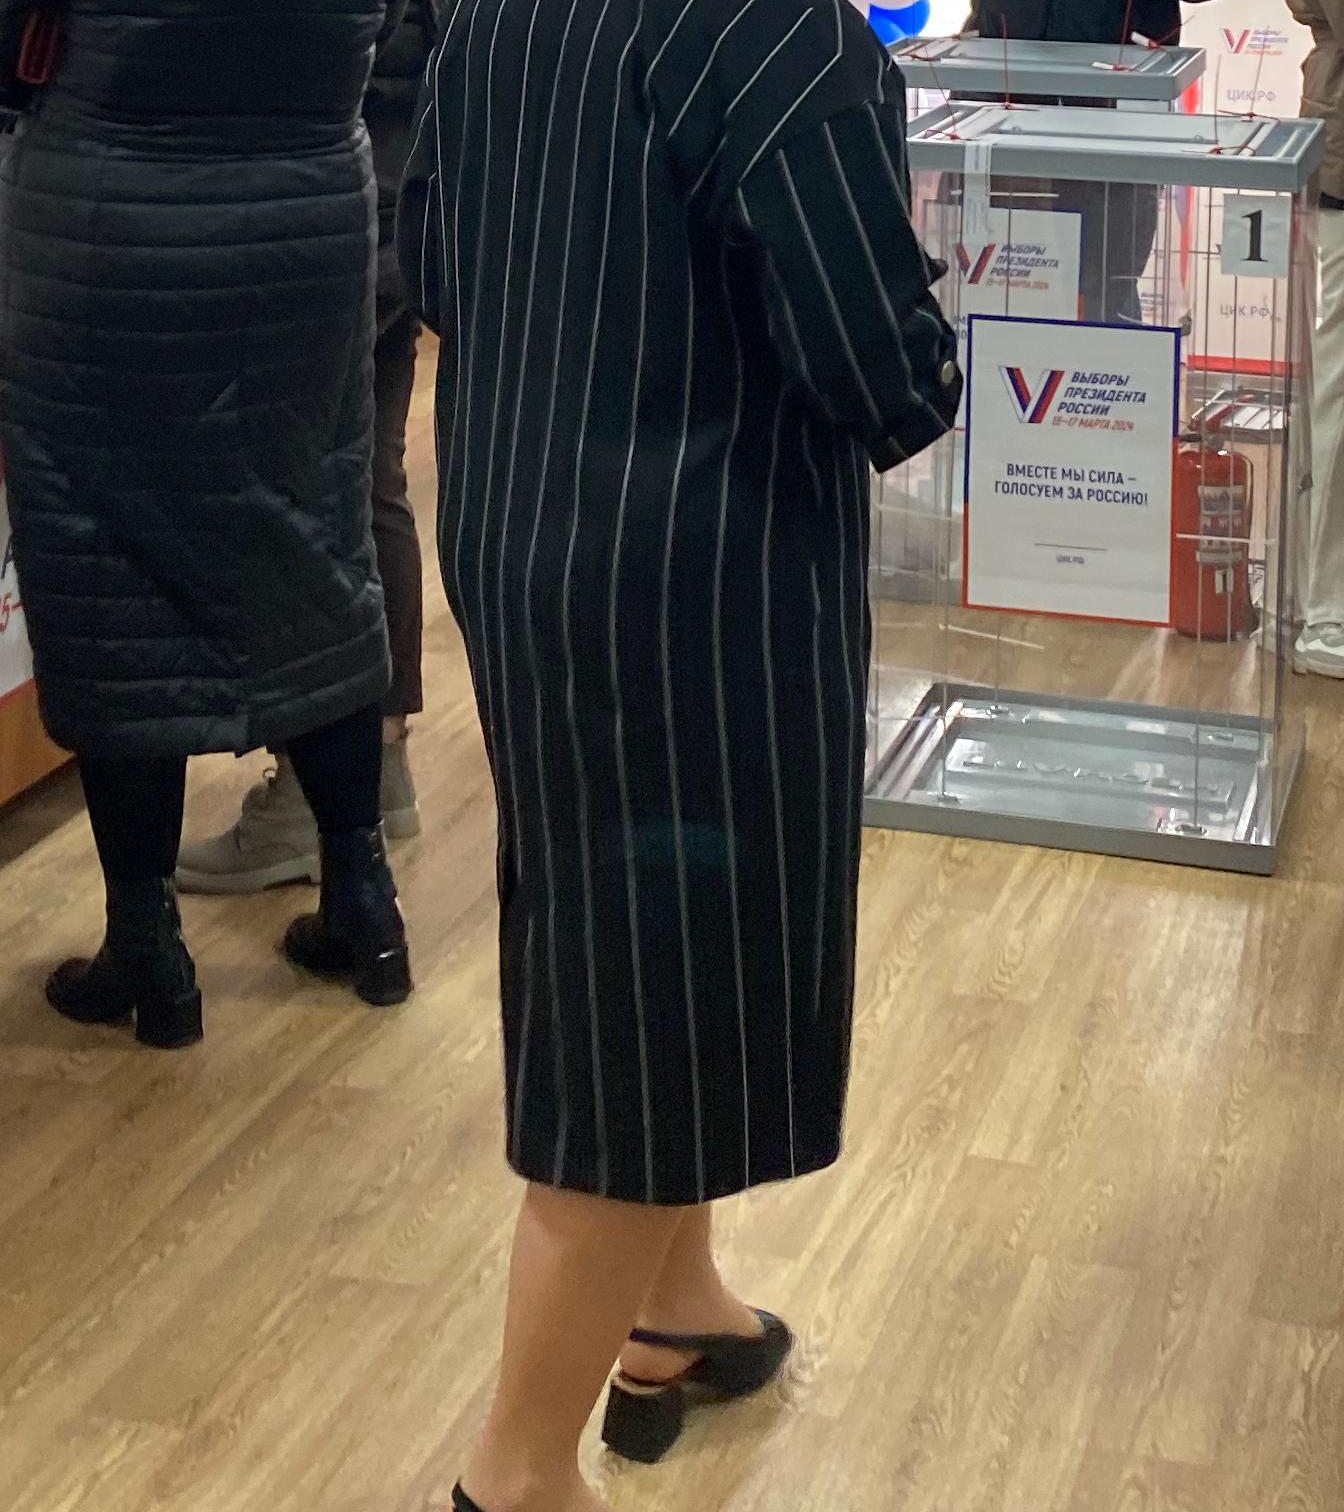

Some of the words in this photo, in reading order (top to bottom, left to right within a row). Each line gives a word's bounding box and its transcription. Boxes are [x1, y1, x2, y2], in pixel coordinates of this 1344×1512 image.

[1241, 209, 1269, 263] 1
[1001, 244, 1047, 255] ВЫБОРЫ
[996, 255, 1059, 269] ПРЕЗИДЕНТА
[990, 267, 1031, 278] РОССИИ
[1071, 371, 1131, 387] ВЫБОРЫ
[1064, 386, 1146, 403] ПРЕЗИДЕНТА
[1057, 401, 1111, 415] РОССИИ
[1078, 418, 1110, 431] МАРТА
[1111, 419, 1135, 432] 2024
[1007, 463, 1057, 480] ВМЕСТЕ
[1061, 468, 1085, 482] МЫ
[1088, 469, 1124, 485] СИЛА
[994, 480, 1063, 499] ГОЛОСУЕМ
[1067, 486, 1083, 500] ЗА
[1087, 488, 1148, 506] РОССИЮ!
